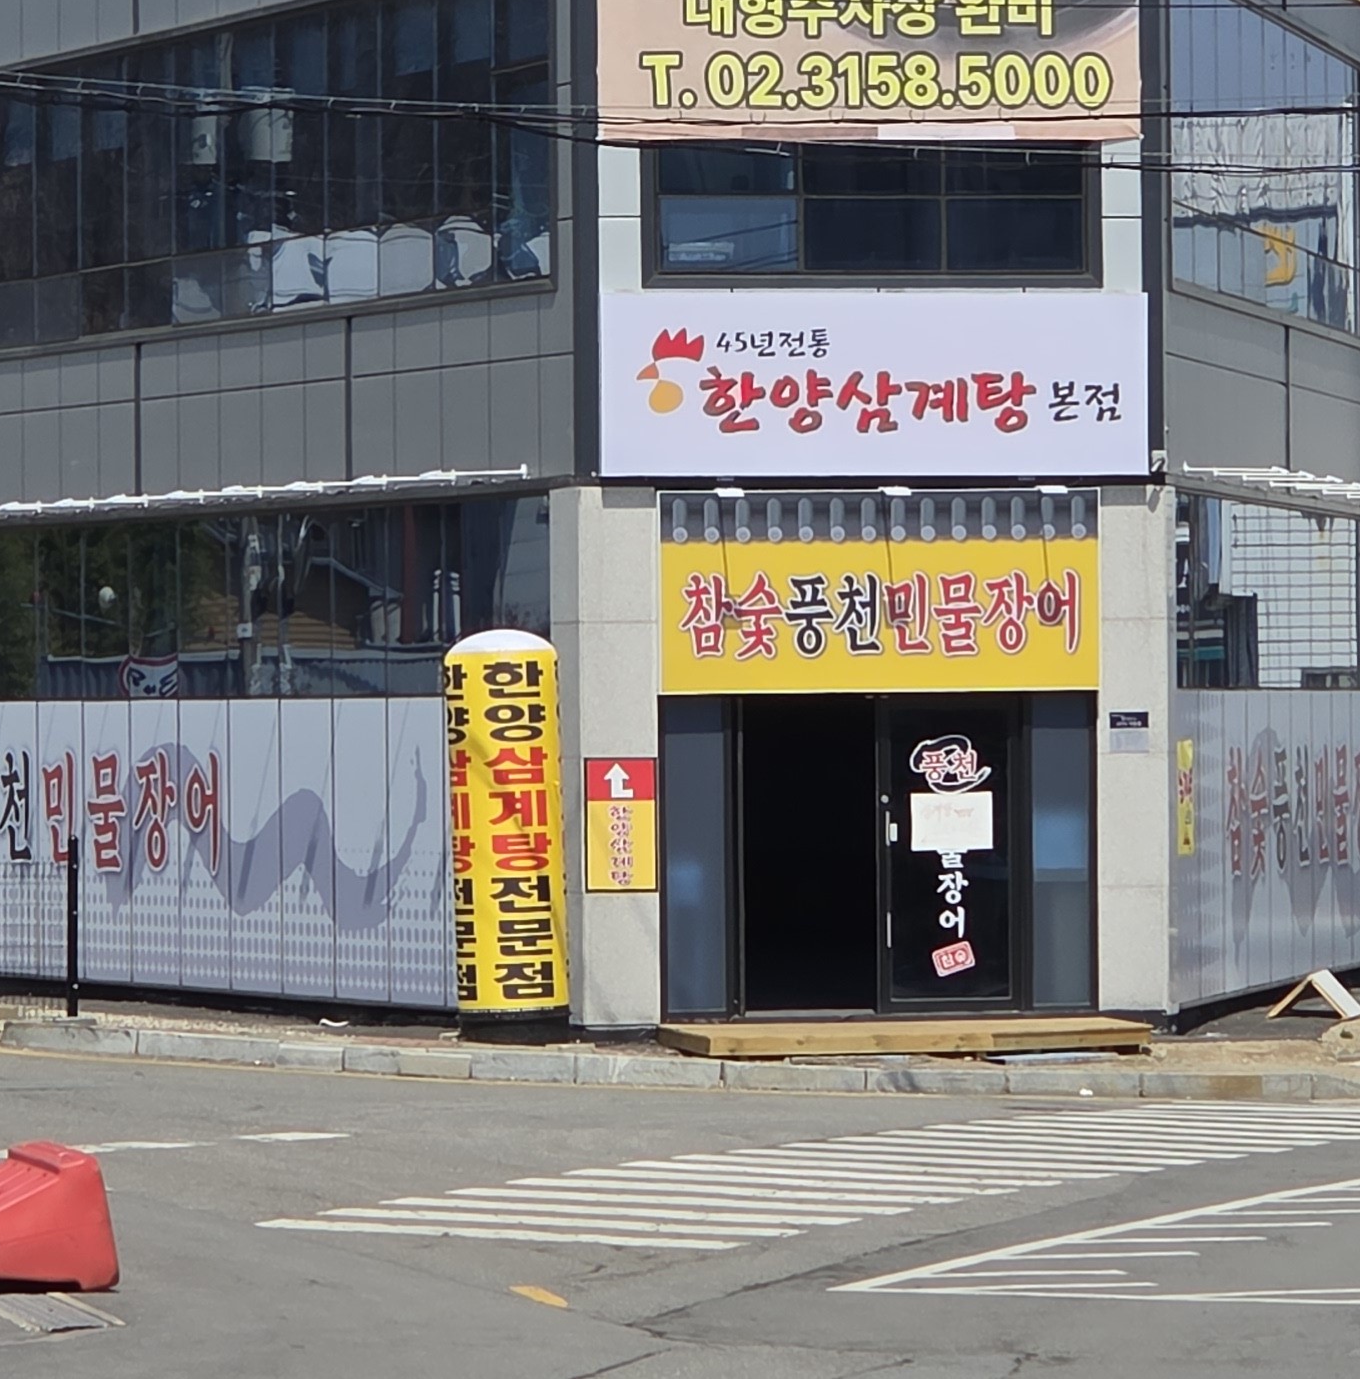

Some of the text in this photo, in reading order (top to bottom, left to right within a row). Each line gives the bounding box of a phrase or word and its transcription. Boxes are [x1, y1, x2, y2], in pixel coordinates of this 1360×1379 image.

[715, 328, 831, 359] 45년전통
[699, 366, 1123, 434] 한양삼계탕 본점
[681, 570, 1082, 659] 참숯풍천민물장어
[920, 748, 977, 782] 풍천
[482, 660, 555, 1001] 한양삼계탕전문점
